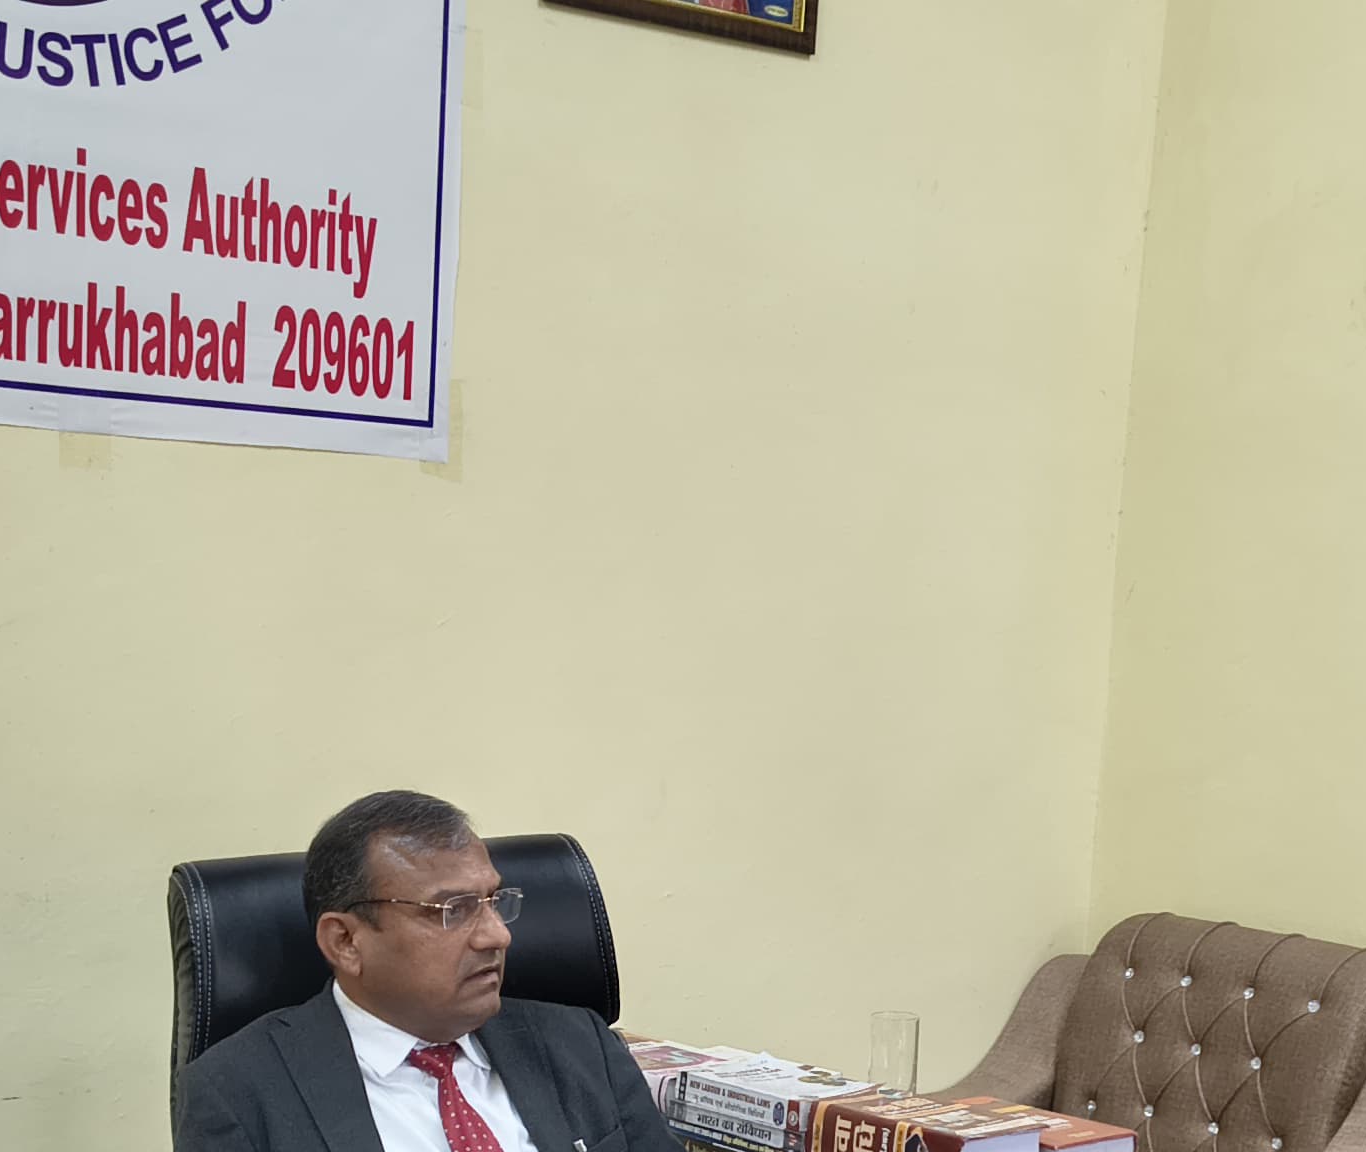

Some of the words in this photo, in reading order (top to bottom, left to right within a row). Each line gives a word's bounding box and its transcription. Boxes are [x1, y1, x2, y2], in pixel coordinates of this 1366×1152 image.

[183, 167, 378, 299] Authority
[272, 305, 415, 401] 209601
[697, 1113, 719, 1128] भारत
[721, 1118, 735, 1132] का
[736, 1119, 772, 1142] संविधान
